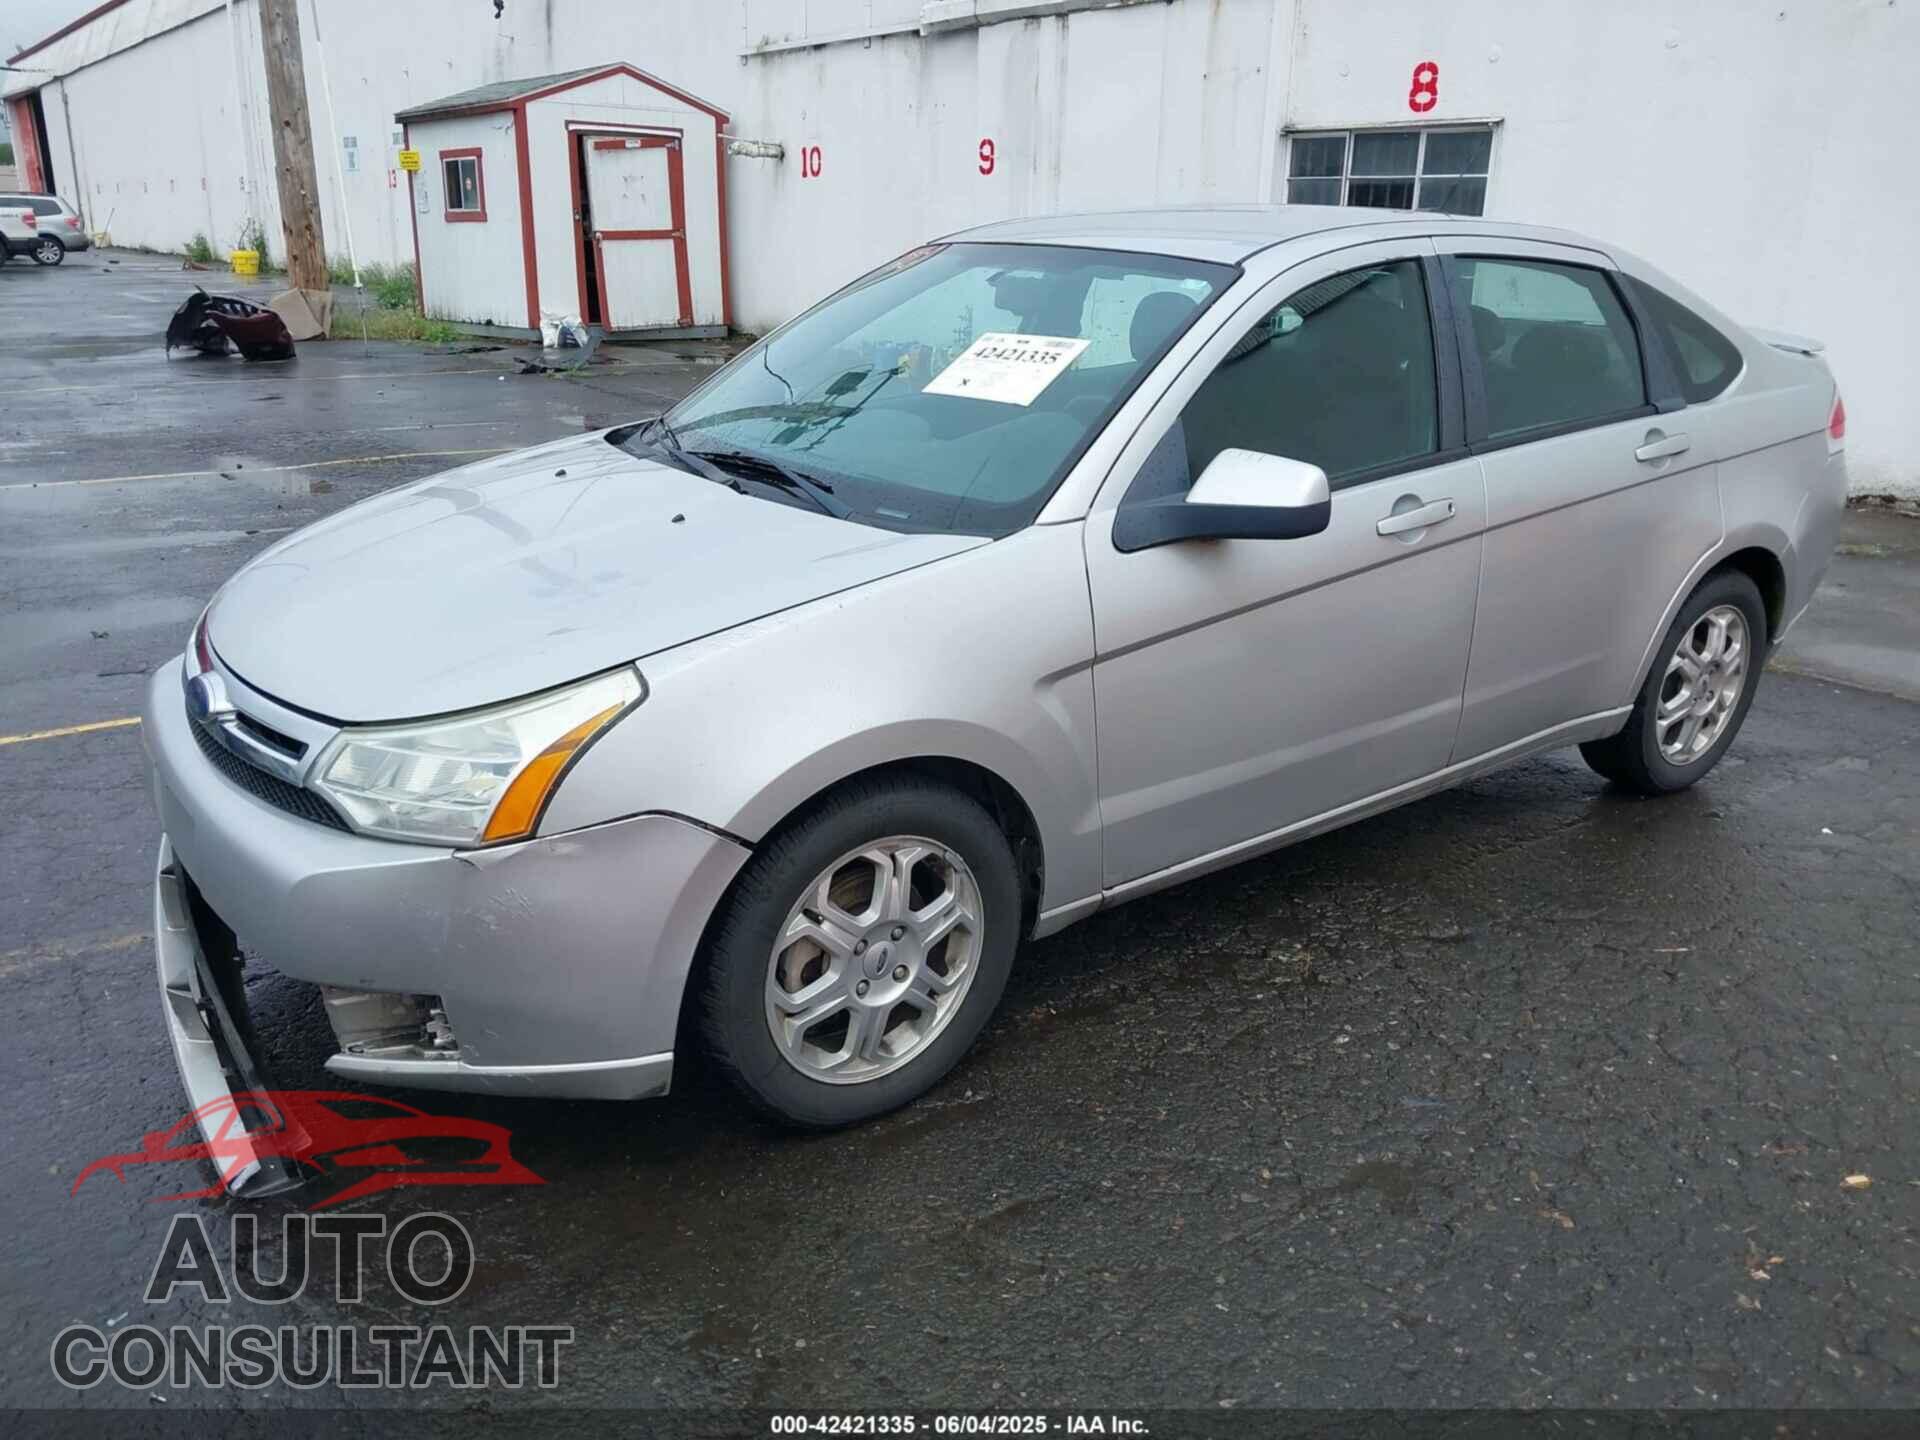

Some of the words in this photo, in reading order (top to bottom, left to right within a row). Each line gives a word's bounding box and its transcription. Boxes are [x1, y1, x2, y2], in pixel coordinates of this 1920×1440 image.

[1409, 61, 1439, 113] 8
[801, 146, 822, 178] 10
[979, 138, 995, 176] 9
[974, 347, 1063, 365] 42421335
